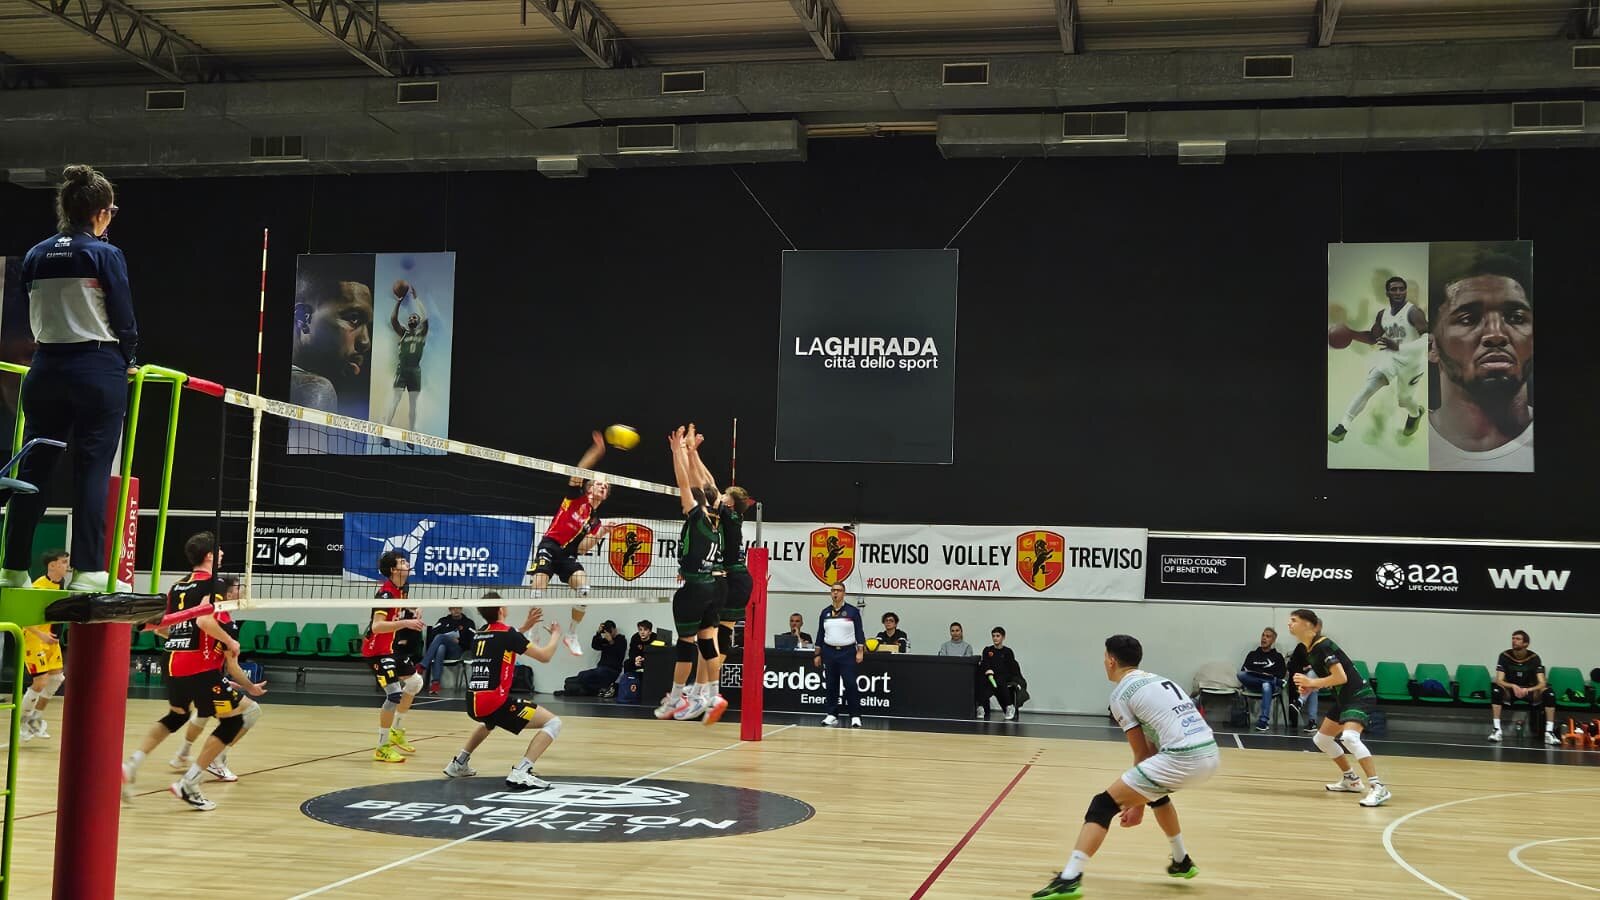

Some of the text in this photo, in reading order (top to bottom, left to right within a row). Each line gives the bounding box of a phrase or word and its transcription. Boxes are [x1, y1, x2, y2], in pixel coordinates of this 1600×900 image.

[795, 336, 938, 356] LAGHIRADA
[824, 356, 938, 371] città dello sport
[125, 497, 138, 581] VISPORT
[277, 526, 309, 535] Industries
[424, 546, 490, 561] STUDIO
[859, 543, 929, 564] TREVISO
[943, 545, 1011, 566] VOLLEY
[1069, 547, 1143, 570] TREVISO
[1164, 557, 1227, 567] UNITED COLORS
[423, 562, 500, 577] POINTER
[1164, 565, 1175, 573] OF
[1279, 564, 1353, 581] Telepass
[1408, 564, 1459, 584] a2a
[1488, 564, 1571, 591] wtw
[867, 578, 1001, 592] #CUOREOROGRANATA
[1161, 681, 1183, 701] 7
[344, 800, 738, 829] BENETTON
[368, 810, 667, 834] BASKET
